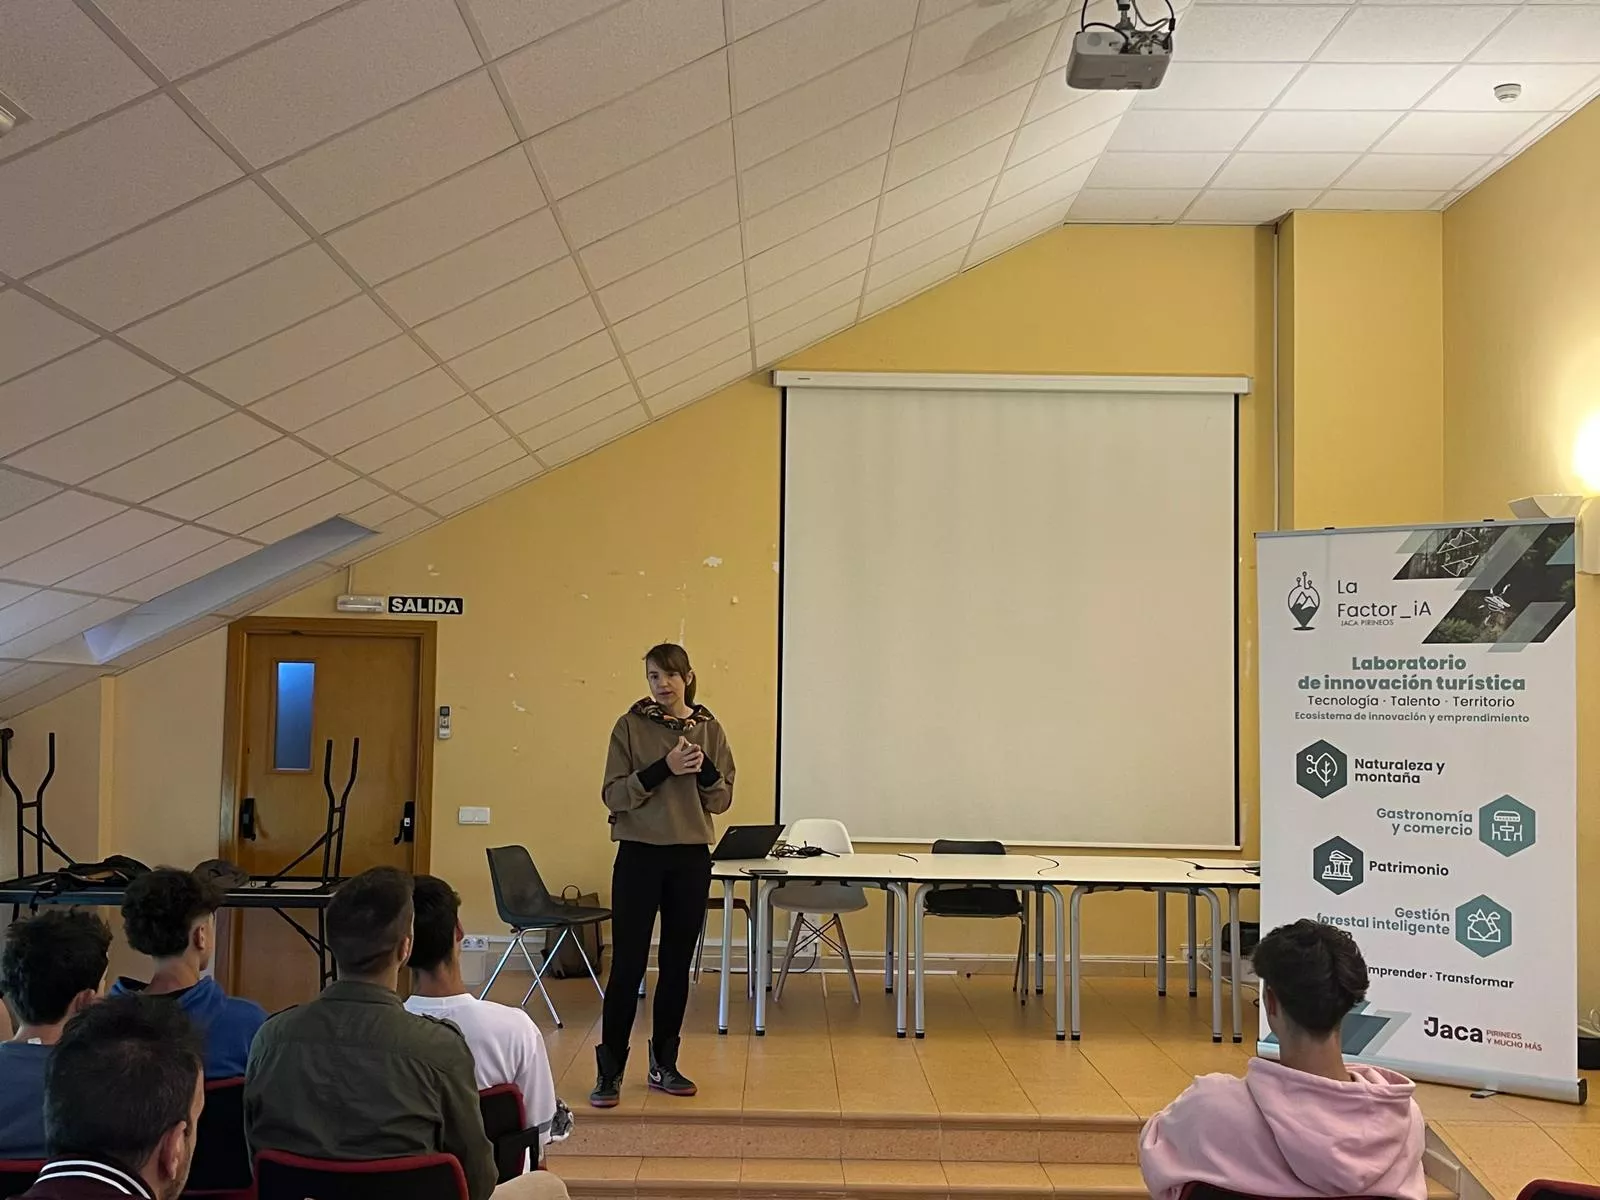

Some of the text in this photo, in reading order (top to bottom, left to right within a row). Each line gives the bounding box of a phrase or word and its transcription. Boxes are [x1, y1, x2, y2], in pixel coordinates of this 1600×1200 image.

[1337, 579, 1358, 594] La
[391, 598, 460, 613] SALIDA
[1337, 600, 1432, 618] Factor_iA
[1341, 619, 1395, 627] JACA PIRINEOS
[1351, 655, 1467, 670] Laboratorio
[1297, 674, 1526, 691] de innovación turística
[1307, 695, 1515, 709] Tecnología Talento Territorio
[1294, 711, 1530, 725] Ecosistema de innovación y emprendimiento
[1354, 758, 1446, 775] Naturaleza y
[1354, 771, 1421, 783] montaña
[1376, 807, 1473, 823] Gastronomía
[1391, 823, 1473, 836] y comercio
[1368, 860, 1449, 876] Patrimonio
[1394, 907, 1450, 921] Gestión
[1316, 912, 1450, 936] forestal inteligente
[1367, 966, 1514, 988] mprender Transformar
[1423, 1016, 1484, 1043] Jaca
[1486, 1029, 1522, 1040] PIRINEOS
[1494, 1038, 1523, 1048] MUCHO
[1524, 1041, 1543, 1052] MÁS
